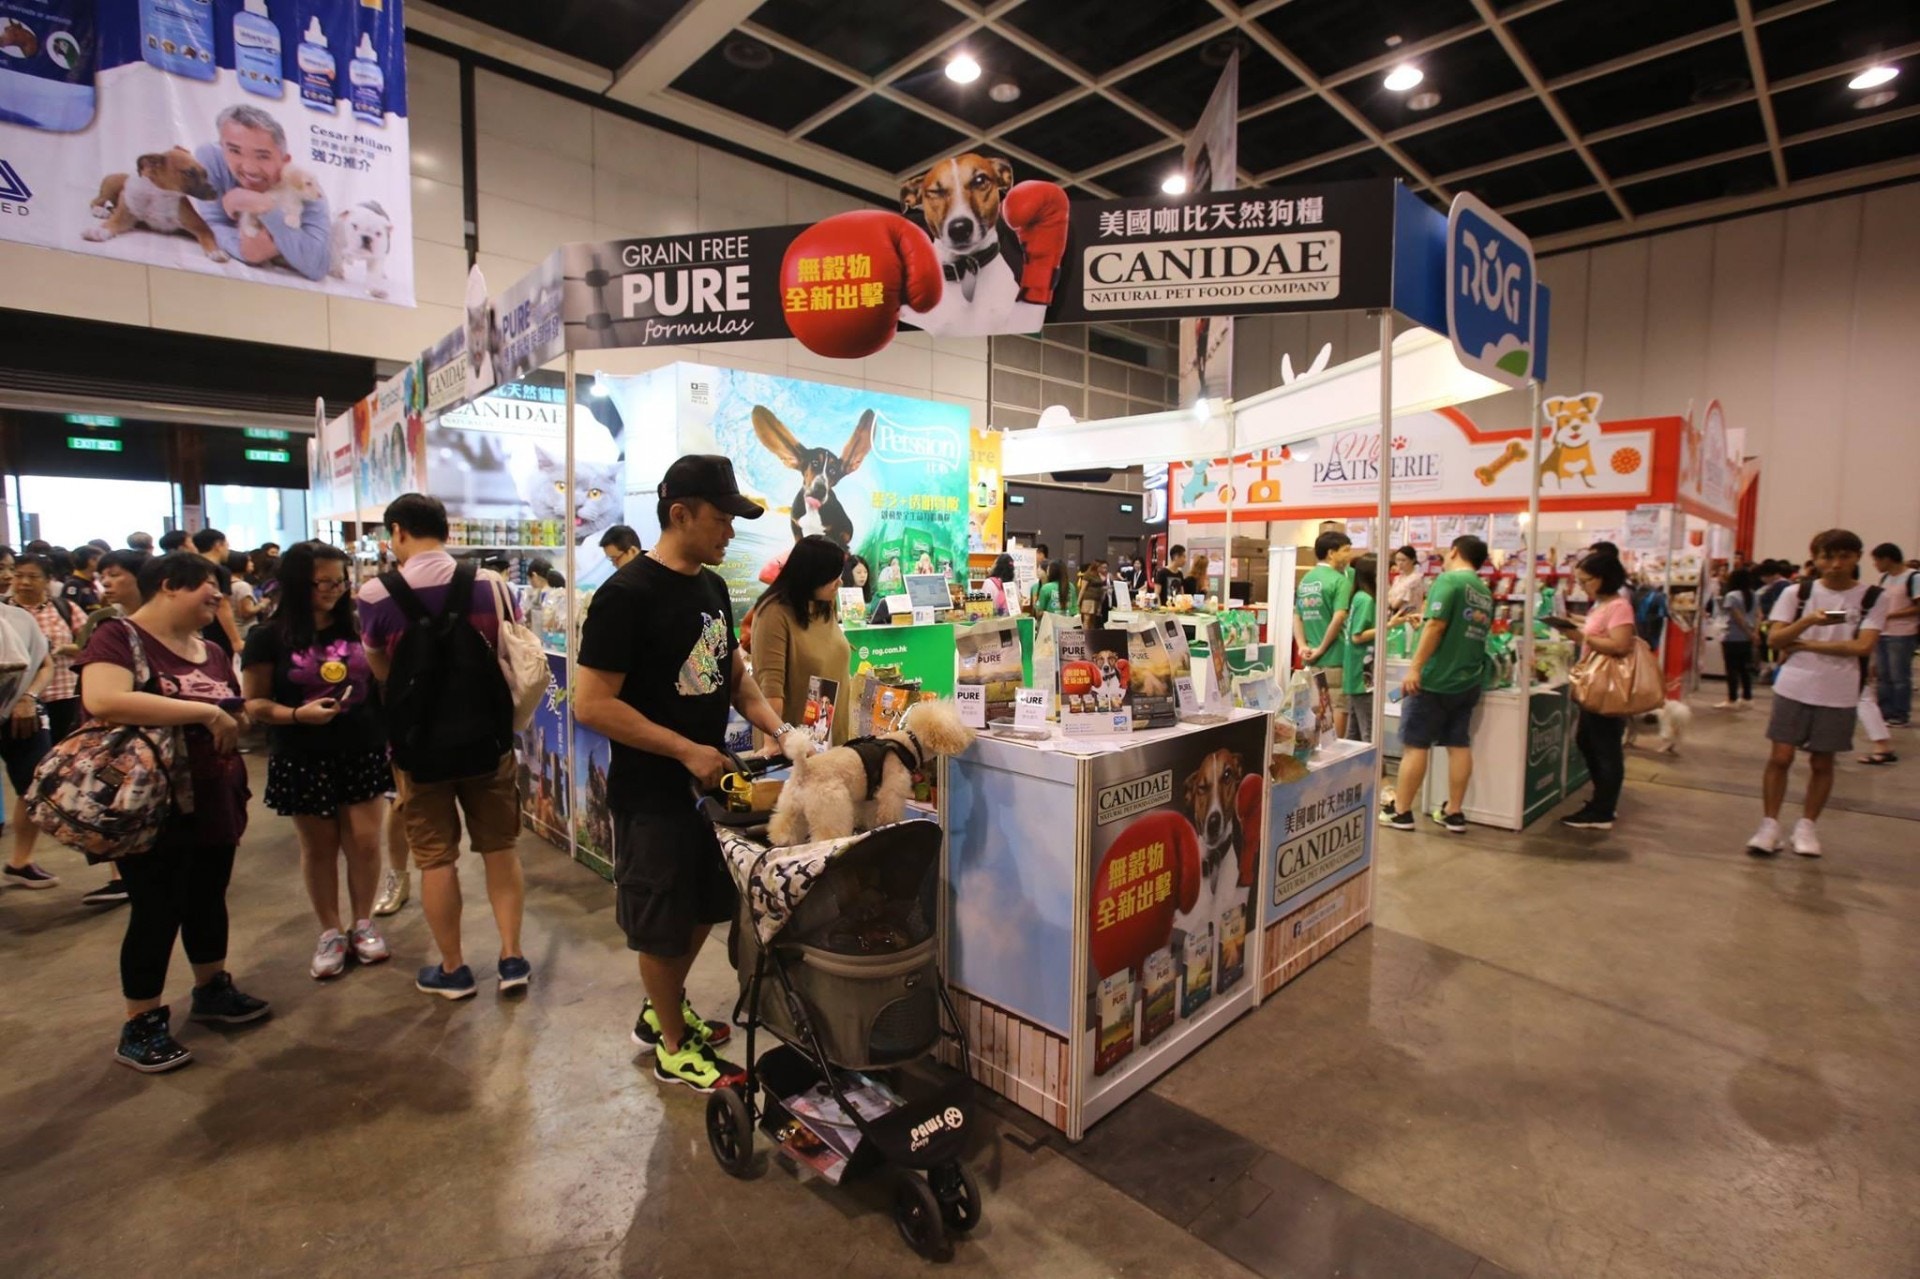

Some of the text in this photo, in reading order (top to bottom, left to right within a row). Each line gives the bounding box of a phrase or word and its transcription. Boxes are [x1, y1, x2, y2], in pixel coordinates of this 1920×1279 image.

[310, 124, 349, 142] Cesar
[311, 148, 371, 172] 強力推介
[1099, 197, 1325, 238] 美國咖比天然狗糧
[622, 235, 749, 267] GRAIN FREE
[1089, 240, 1330, 285] CANIDAE
[797, 253, 871, 282] 無穀物
[622, 265, 750, 318] PURE
[785, 282, 885, 313] 全新出擊
[1090, 281, 1330, 304] NATURAL PET FOOD COMPANY
[502, 299, 530, 341] PURE
[642, 314, 755, 345] formulas
[1312, 453, 1440, 483] PATISERIE
[872, 645, 908, 656] rog.com.hk
[977, 653, 1002, 665] PURE
[1062, 646, 1086, 656] PURE
[957, 691, 980, 701] PURE
[1100, 774, 1170, 811] CANIDAE
[1100, 808, 1123, 821] NATURAL
[1278, 814, 1362, 878] CANIDAE
[1108, 841, 1165, 890] 無穀物
[1097, 870, 1172, 931] 全新出擊
[911, 1114, 944, 1142] PAWS
